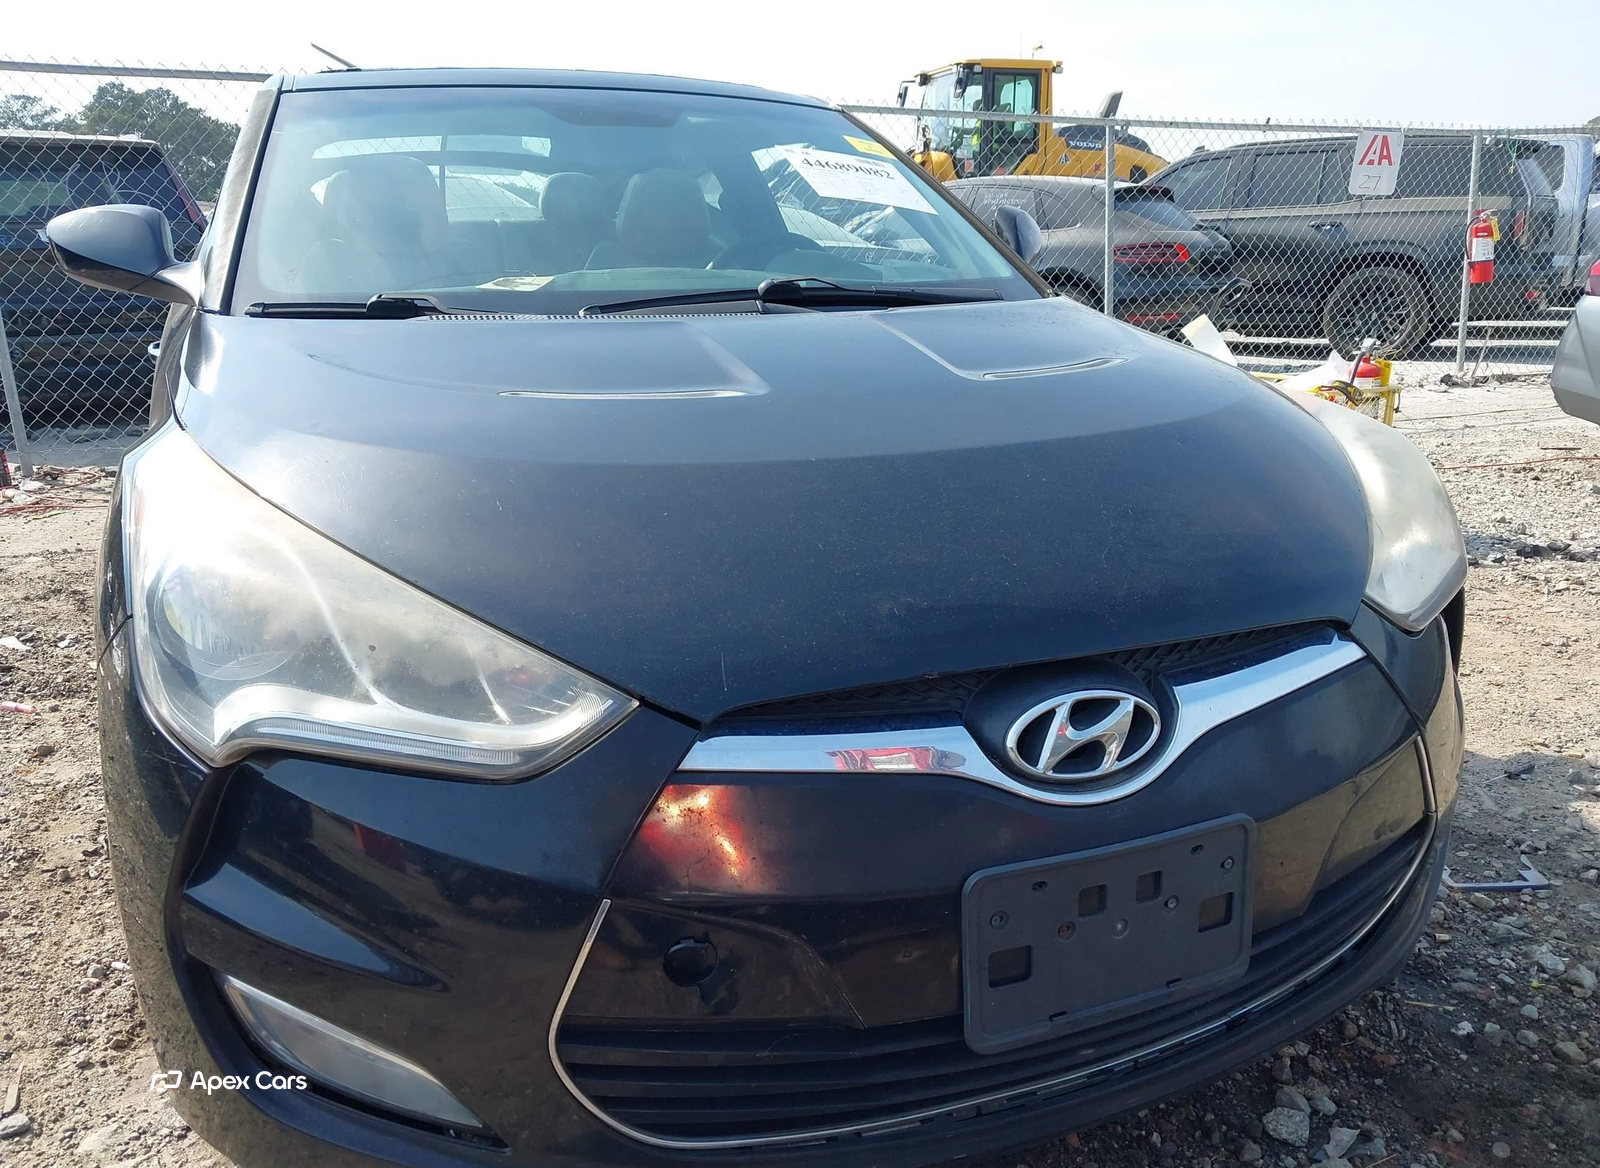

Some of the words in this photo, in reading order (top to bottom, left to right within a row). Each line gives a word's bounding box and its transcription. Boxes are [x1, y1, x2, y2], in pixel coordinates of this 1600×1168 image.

[1069, 140, 1102, 149] VOLVO
[801, 157, 896, 180] 44689082
[1358, 174, 1382, 192] 27
